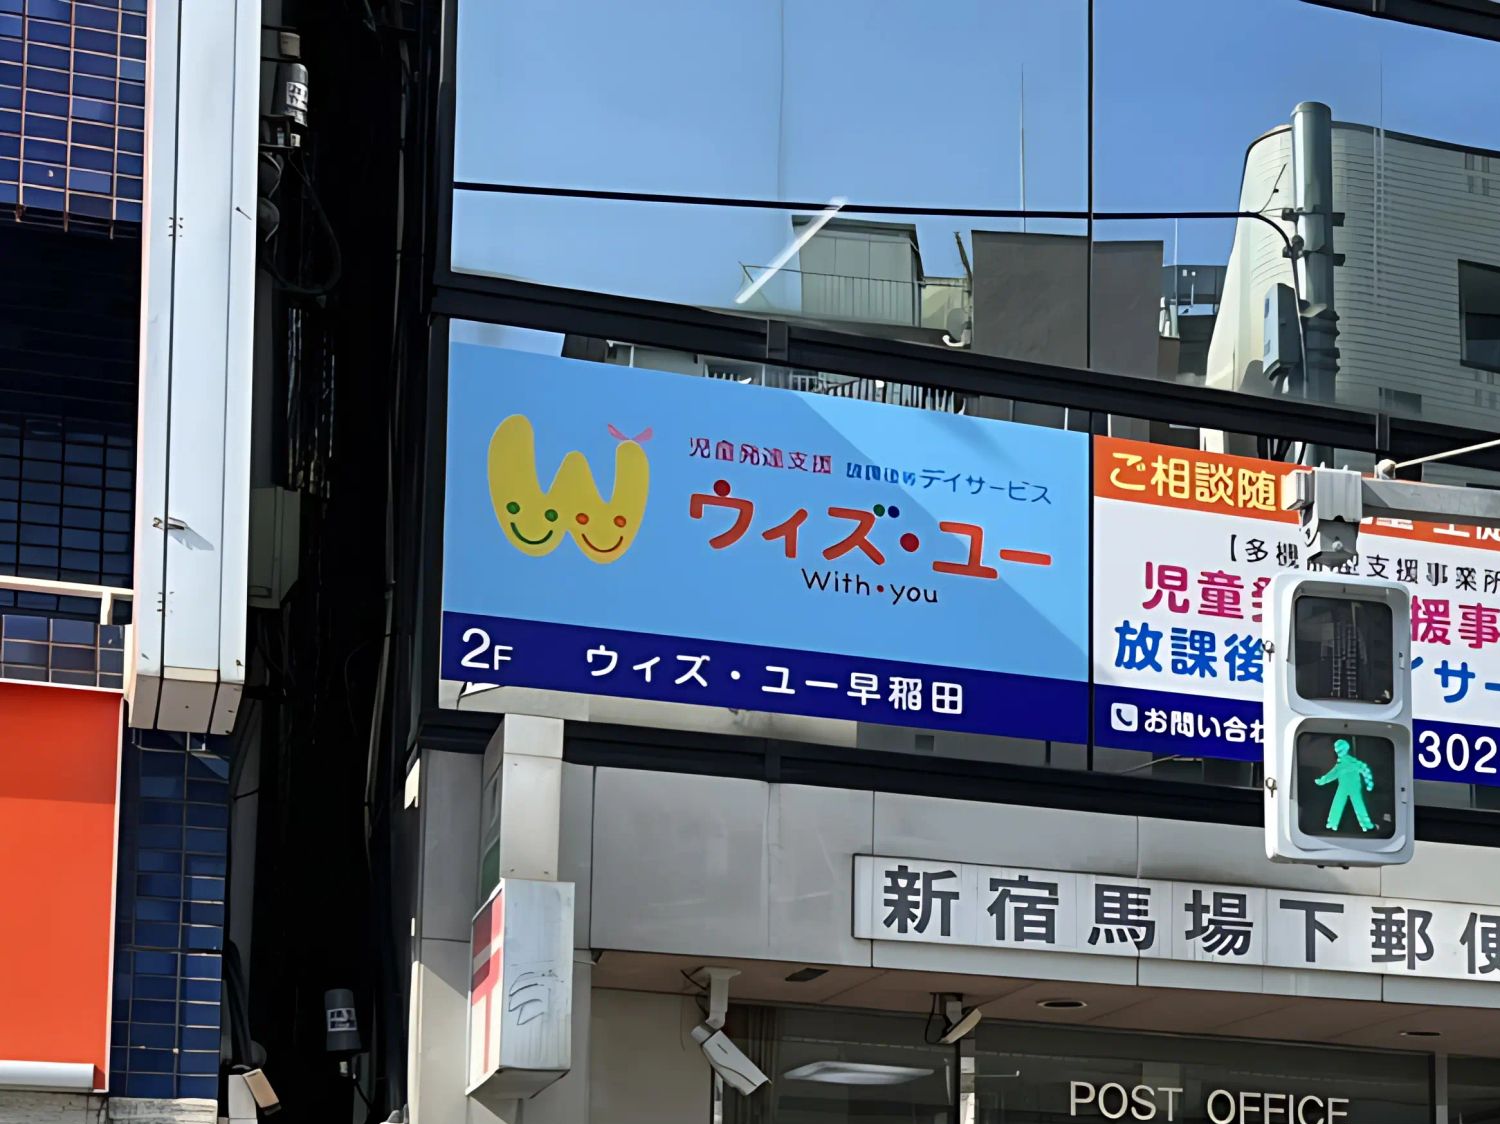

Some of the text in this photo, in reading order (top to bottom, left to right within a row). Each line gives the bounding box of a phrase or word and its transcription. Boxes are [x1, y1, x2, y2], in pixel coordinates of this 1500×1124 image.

[690, 479, 1052, 580] ウィズ・ユー
[460, 628, 964, 716] 2F ウィズ・ユー早稲田
[1069, 1079, 1185, 1123] POST
